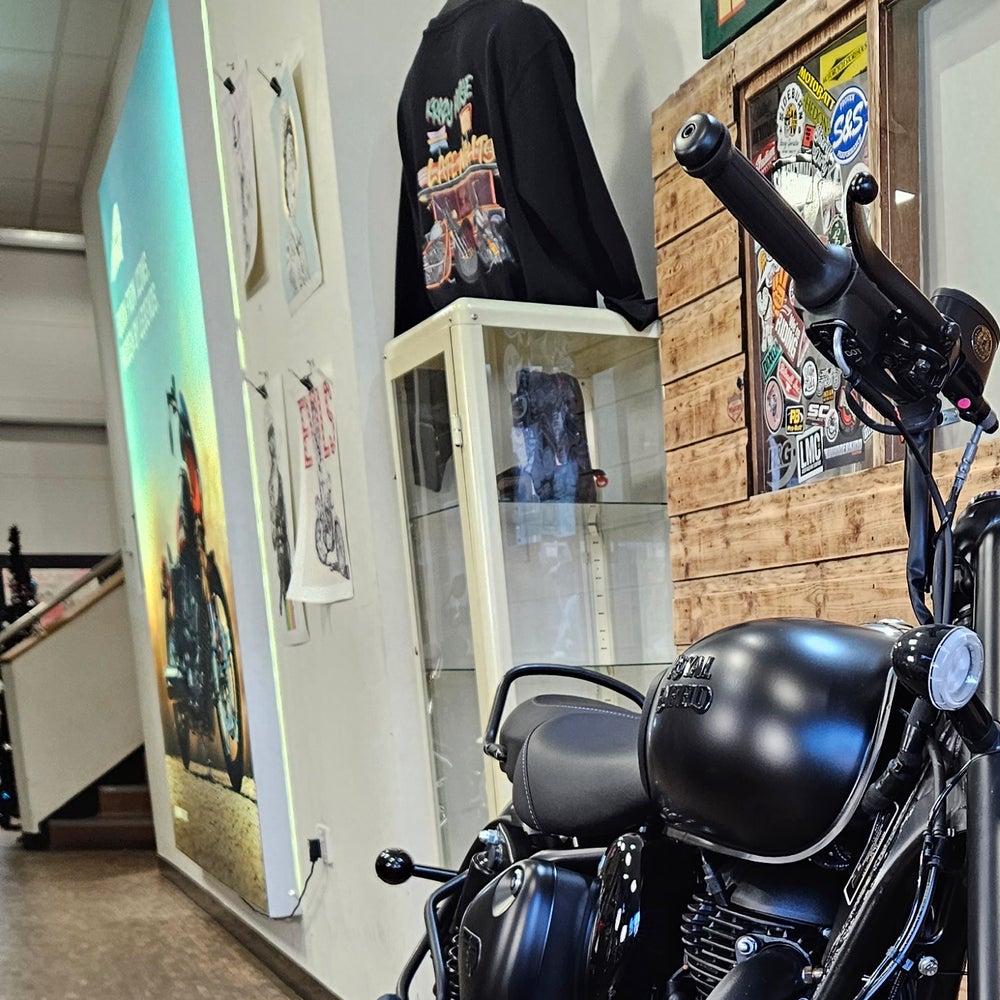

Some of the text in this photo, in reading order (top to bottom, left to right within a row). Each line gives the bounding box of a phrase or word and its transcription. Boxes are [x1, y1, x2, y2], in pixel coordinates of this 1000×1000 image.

[799, 66, 836, 111] MOTOBATT
[833, 100, 864, 150] S&S
[800, 432, 820, 467] LMC
